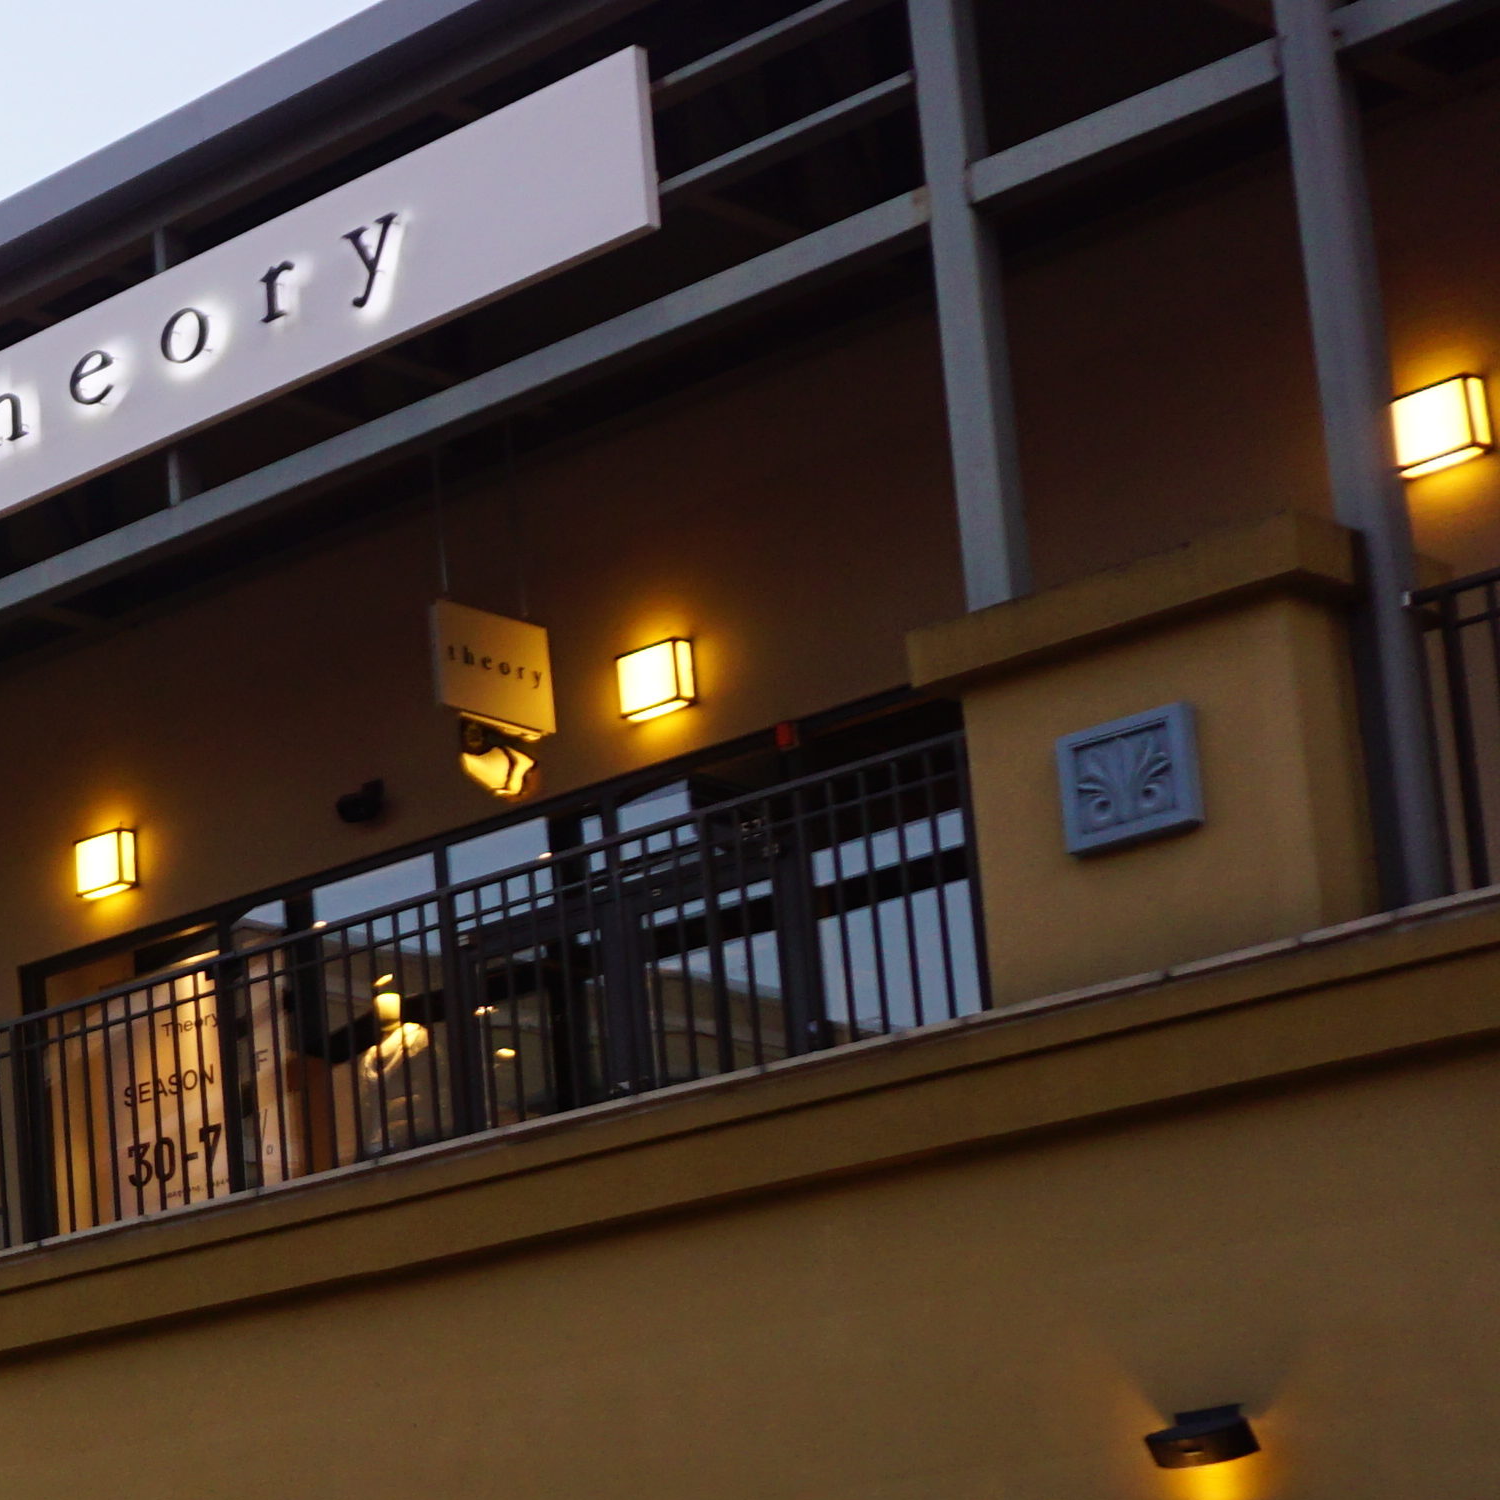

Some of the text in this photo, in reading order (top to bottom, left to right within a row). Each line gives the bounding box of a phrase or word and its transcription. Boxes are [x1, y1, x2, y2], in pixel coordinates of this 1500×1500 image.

[447, 644, 542, 690] theory
[161, 1012, 219, 1037] Theory
[124, 1063, 215, 1108] SEASON
